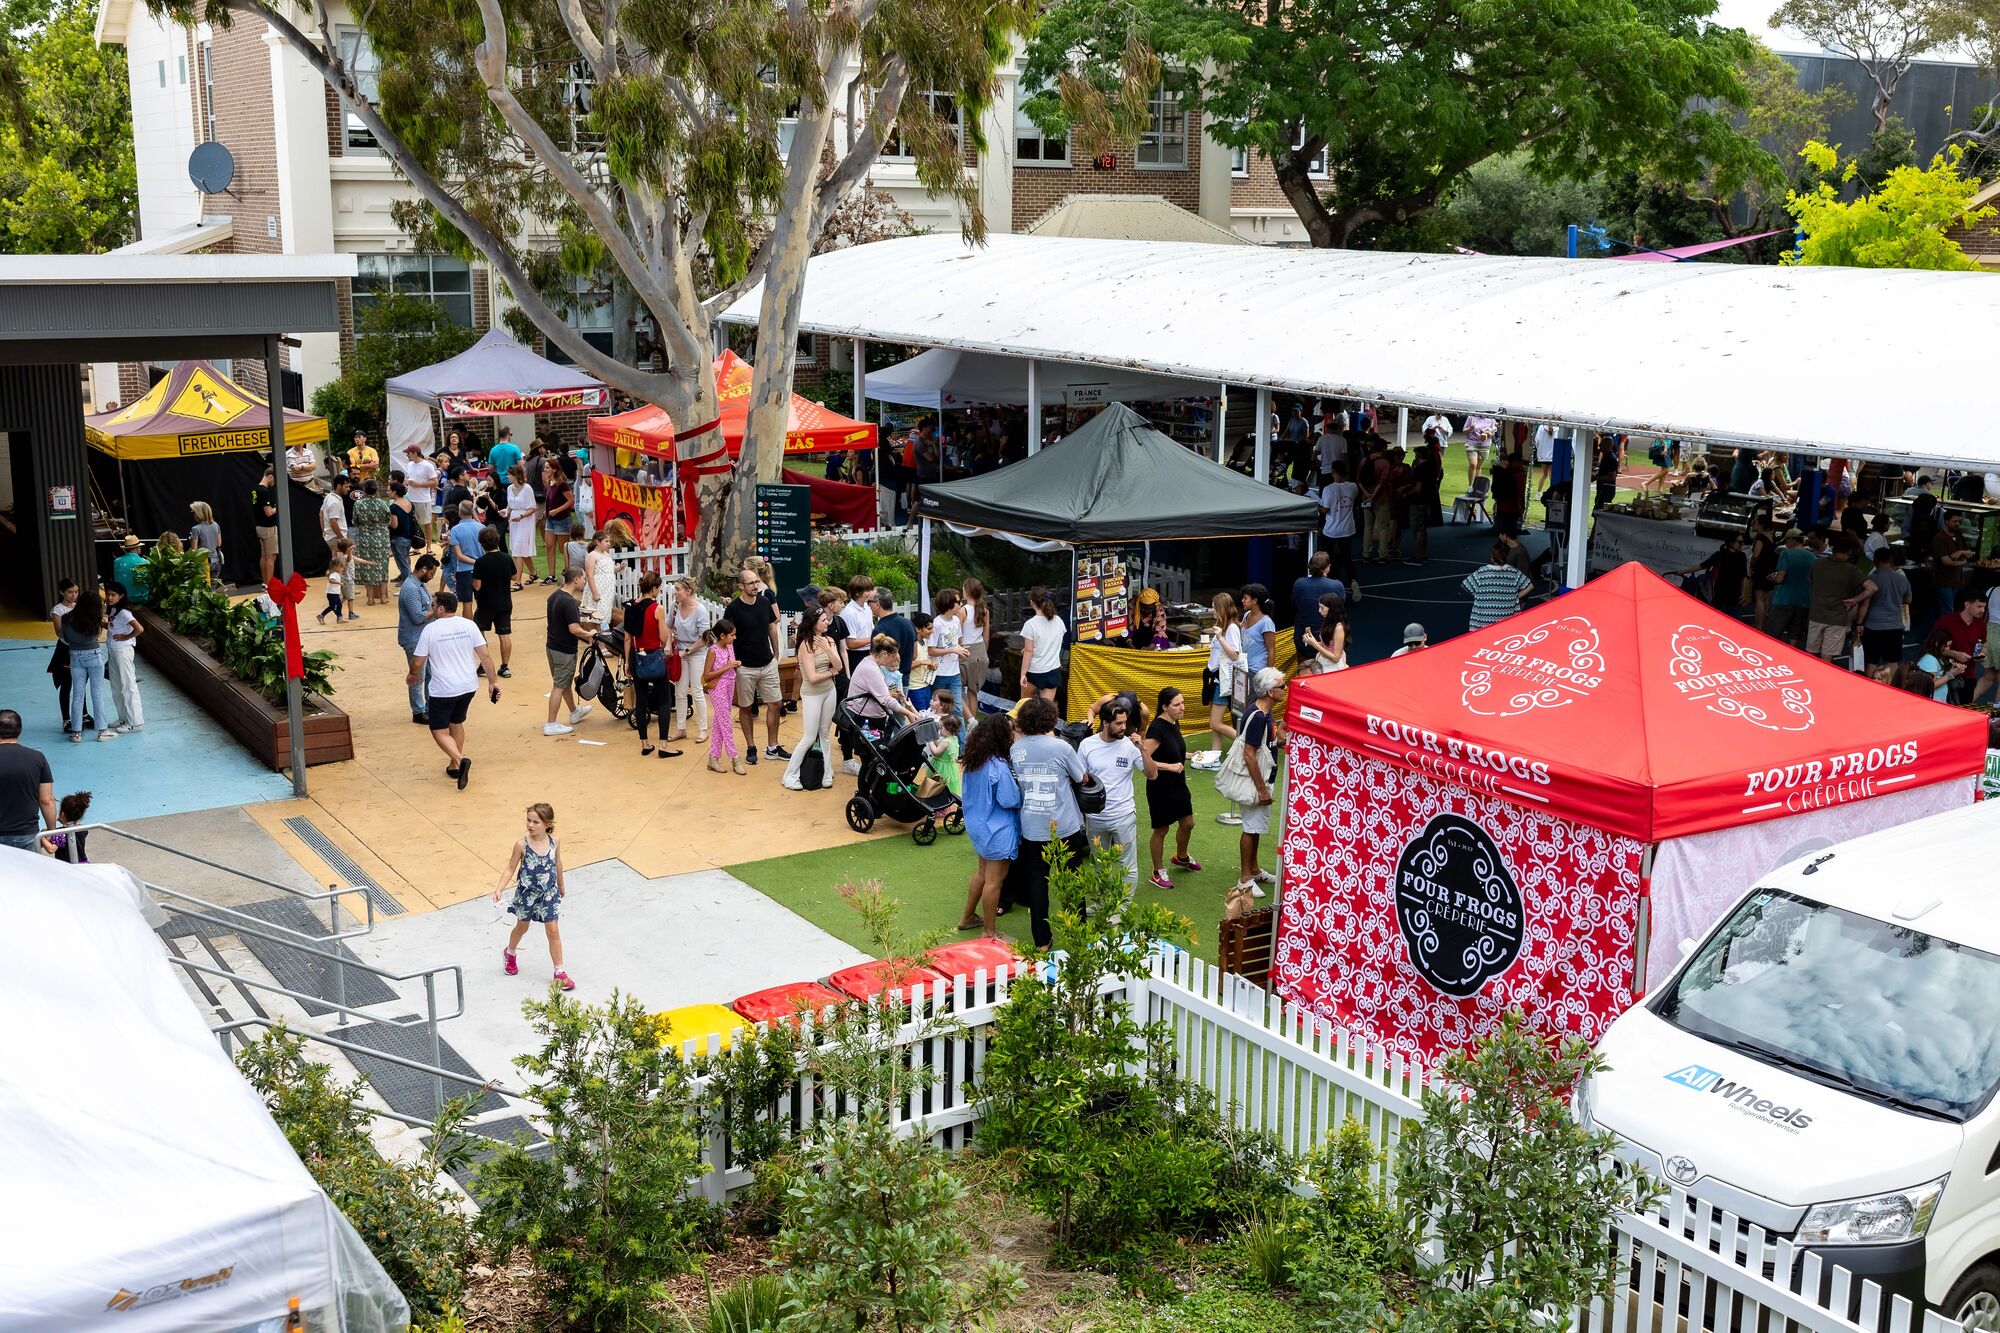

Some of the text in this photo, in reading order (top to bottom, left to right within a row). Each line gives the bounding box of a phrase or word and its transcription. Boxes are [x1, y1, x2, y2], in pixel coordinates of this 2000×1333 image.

[183, 432, 267, 451] FRENCHEESE
[614, 432, 645, 450] PAELLAS
[602, 475, 664, 512] PAELLAS
[1472, 648, 1603, 688] FOUR FROGS
[1673, 665, 1794, 693] FOUR FROGS
[1366, 714, 1551, 785] FOUR FROGS
[1744, 740, 1918, 797] FOUR FROGS
[1402, 870, 1517, 929] FOUR FROGS
[1727, 1102, 1800, 1136] Refrigerated rentals
